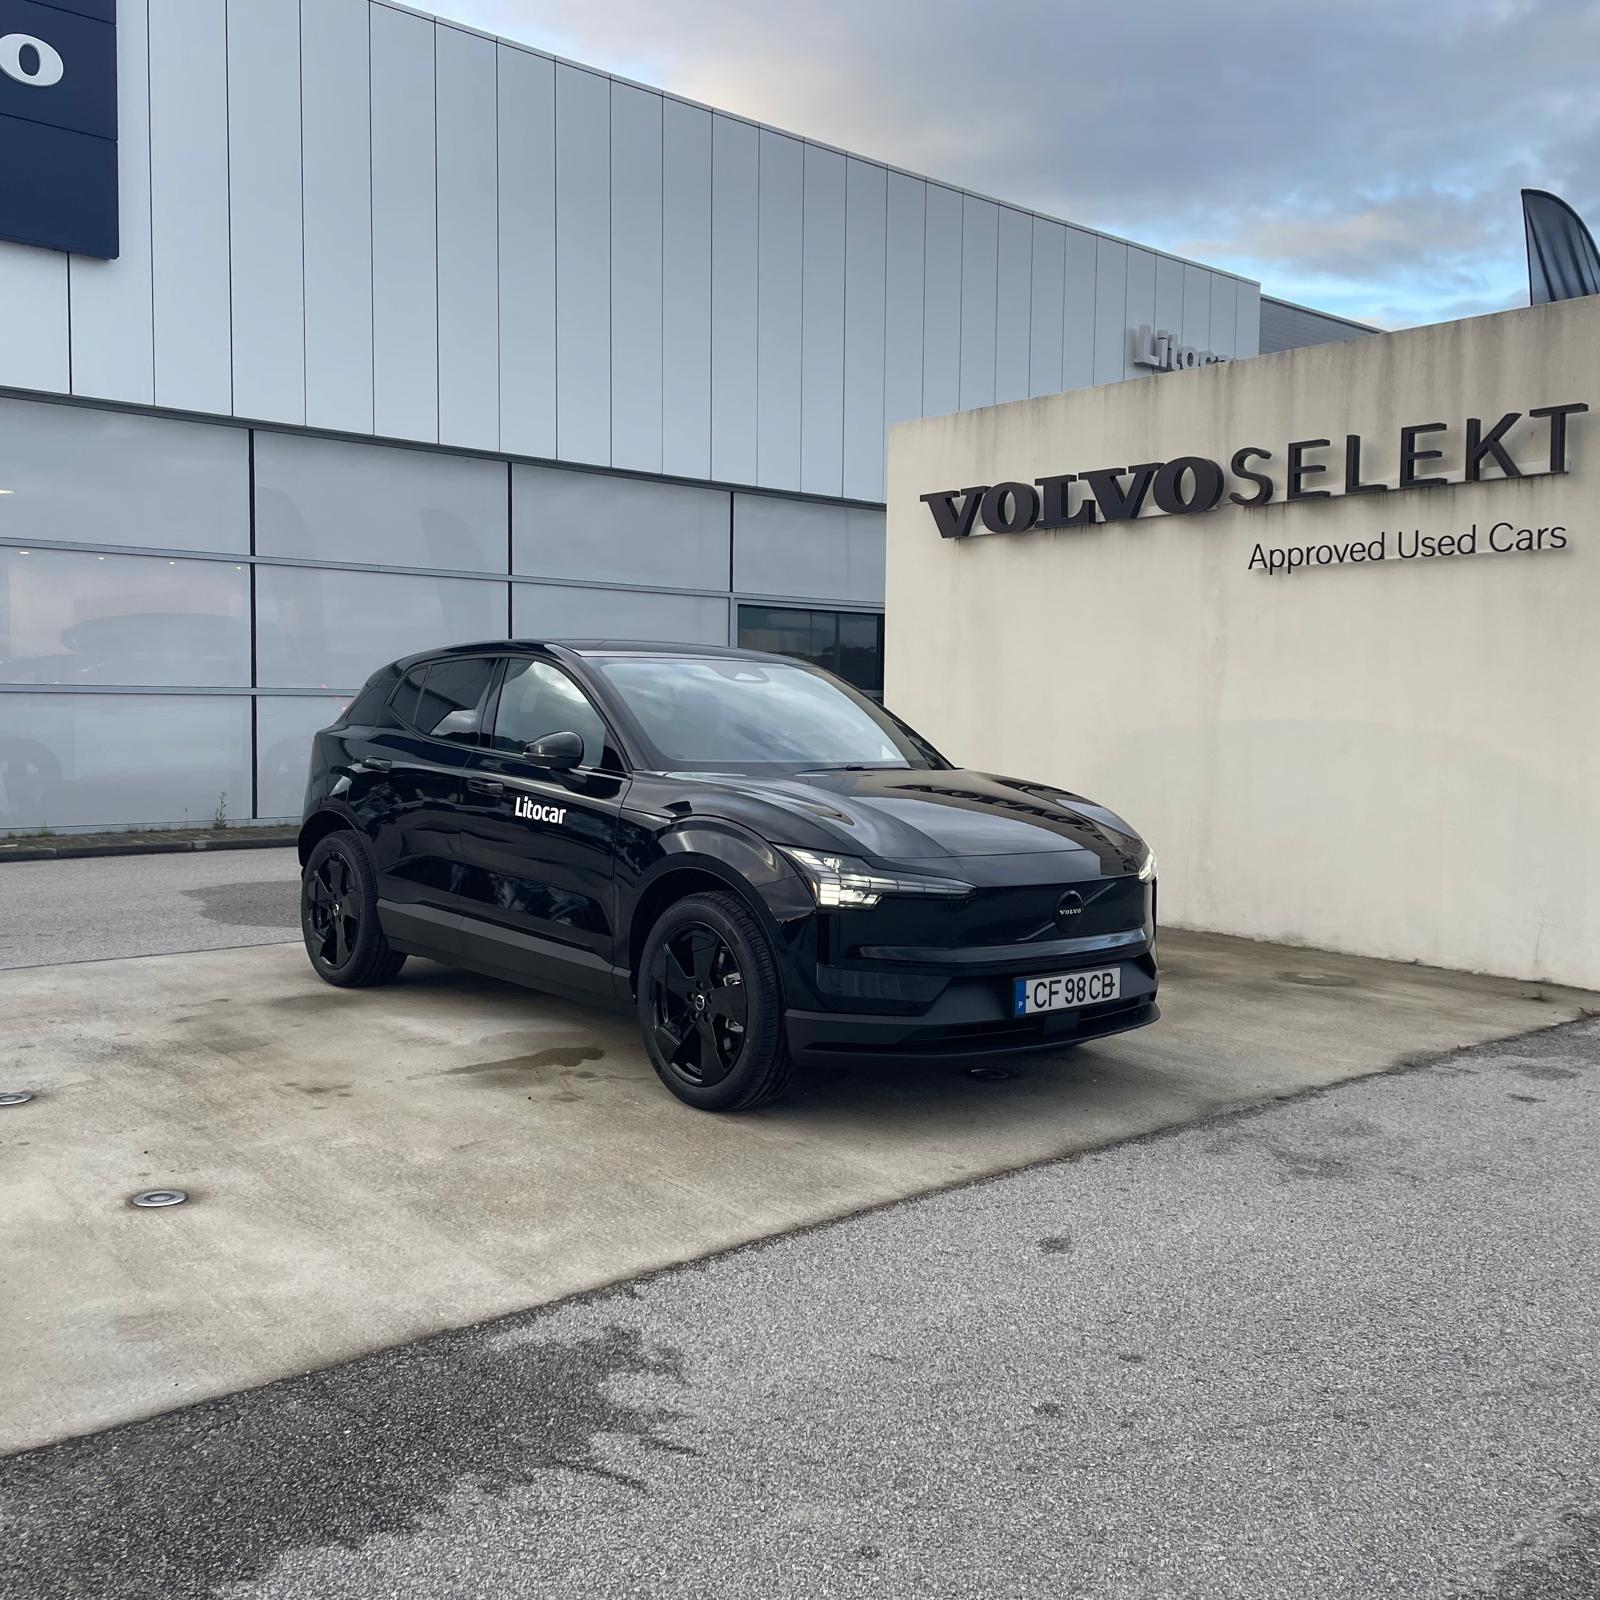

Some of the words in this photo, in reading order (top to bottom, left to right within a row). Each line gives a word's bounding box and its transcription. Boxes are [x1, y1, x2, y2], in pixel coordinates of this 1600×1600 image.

[920, 456, 1224, 539] VOLVO
[1230, 402, 1588, 507] SELEKT
[1248, 531, 1386, 575] Approved
[1397, 524, 1477, 559] Used
[1489, 522, 1567, 552] Cars
[514, 795, 567, 825] Litocar
[1059, 907, 1082, 916] VOLVO
[1017, 1001, 1024, 1009] P
[1033, 980, 1062, 1009] CF
[1064, 976, 1087, 1005] 98
[1089, 972, 1115, 1000] CB
